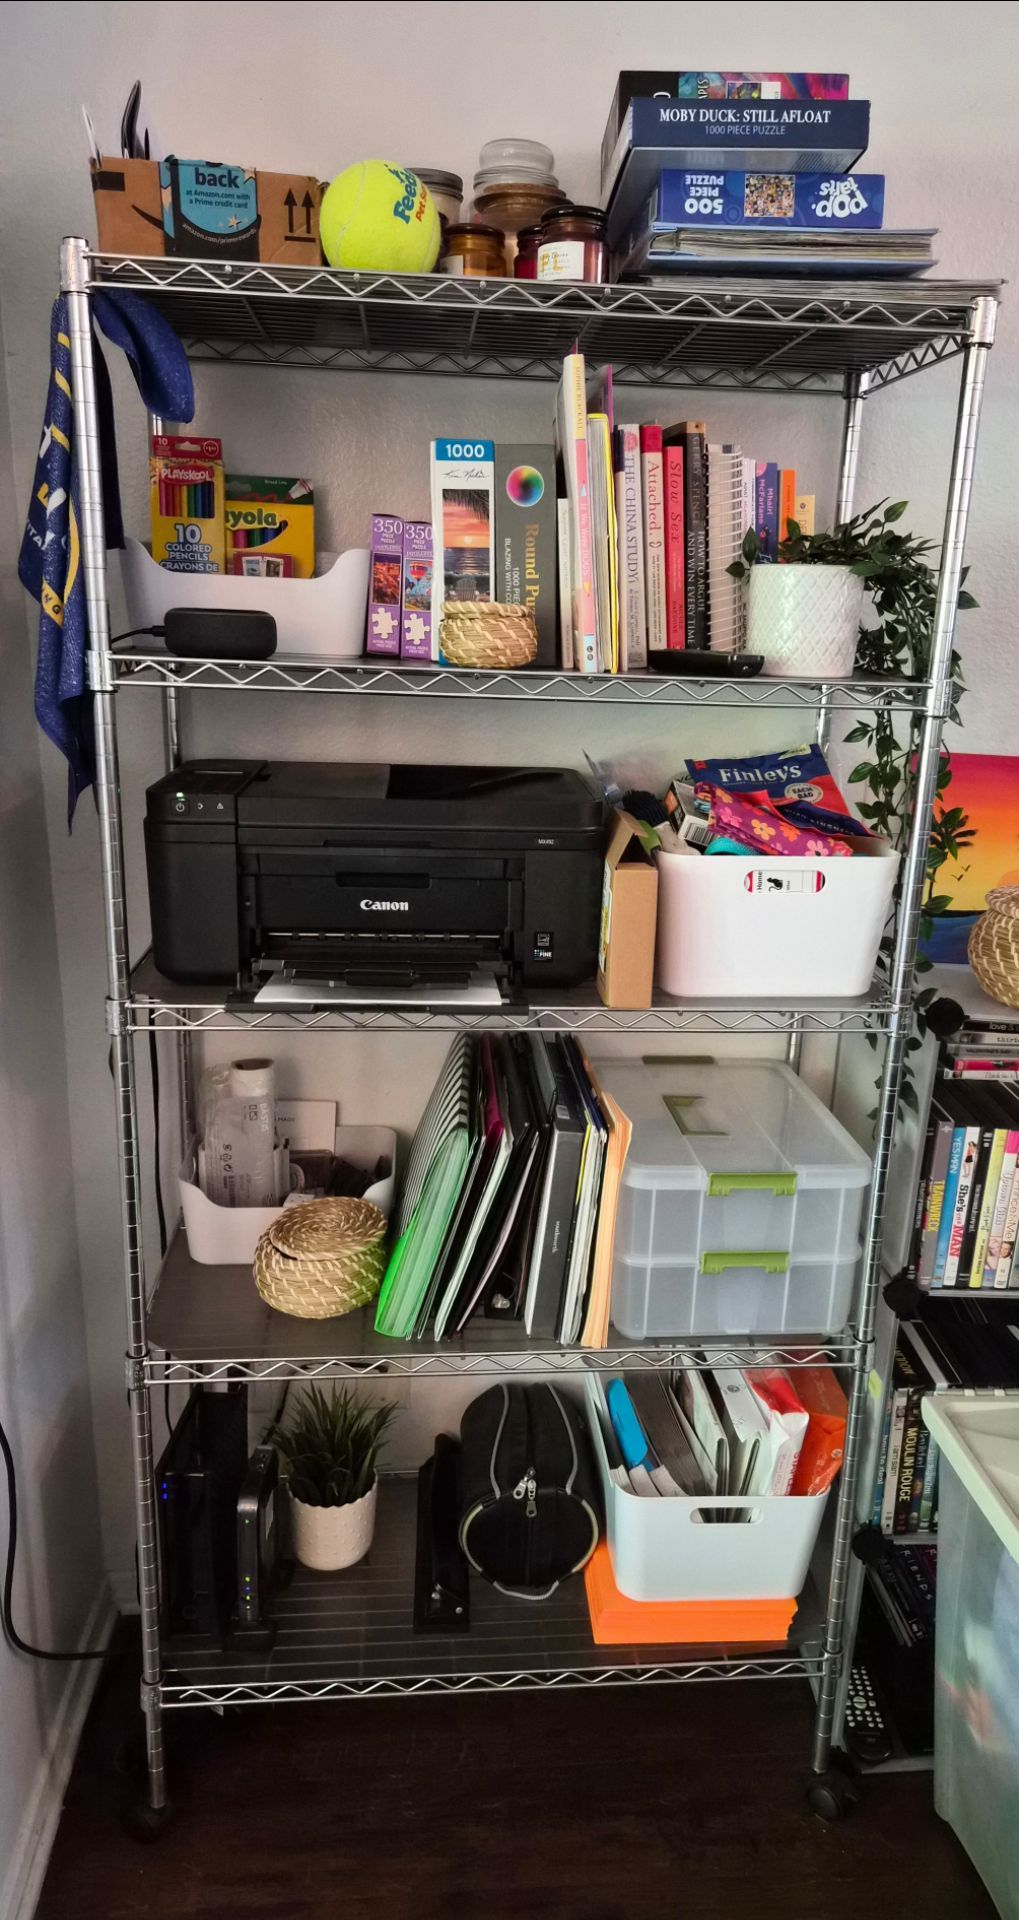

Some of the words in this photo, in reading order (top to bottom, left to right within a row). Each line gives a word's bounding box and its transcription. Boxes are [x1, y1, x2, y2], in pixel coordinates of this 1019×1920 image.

[659, 108, 697, 122] MOBY
[699, 108, 740, 123] DUCK:
[742, 109, 779, 123] STILL
[781, 109, 831, 123] AFLOAT
[705, 125, 726, 135] 1000
[727, 125, 751, 136] PIECE
[752, 125, 786, 136] PUZZLE
[194, 167, 240, 189] back
[685, 174, 725, 186] PUZZLE
[193, 189, 235, 199] Amazon.com
[689, 186, 720, 197] PIECE
[194, 197, 213, 206] Prime
[214, 199, 232, 208] credit
[234, 201, 248, 209] card
[684, 198, 724, 215] 500
[157, 437, 169, 446] 10
[445, 443, 485, 458] 1000
[692, 436, 701, 475] GERRY
[161, 467, 212, 481] PLAYSKOOL
[624, 455, 635, 484] THE
[670, 460, 682, 504] Slow
[648, 460, 662, 536] Attached.
[692, 479, 701, 526] SPENCE
[758, 479, 766, 525] McFarlane
[766, 488, 774, 515] Mhairi
[225, 507, 278, 529] yola
[625, 487, 636, 533] CHINA
[175, 524, 201, 544] 10
[373, 518, 403, 535] 350
[405, 524, 433, 541] 350
[670, 511, 682, 544] Sex
[165, 543, 212, 553] COLORED
[504, 537, 512, 570] BLAZING
[525, 523, 541, 580] Round
[687, 530, 696, 556] AND
[697, 531, 706, 558] HOW
[160, 561, 205, 571] CRAYONS
[205, 563, 219, 572] DE
[169, 551, 209, 561] PENCILS
[626, 535, 638, 581] STUDY
[512, 567, 521, 586] 1000
[687, 558, 696, 582] WIN
[697, 561, 706, 576] TO
[687, 586, 696, 617] EVERY
[697, 577, 706, 612] ARGUE
[687, 619, 696, 645] TIME
[718, 764, 802, 784] Finley's
[791, 786, 814, 795] EACH
[797, 792, 814, 800] BAG
[360, 899, 409, 911] Canon
[951, 1136, 963, 1154] YES
[947, 1153, 959, 1175] MAN
[927, 1180, 947, 1232] TRAINWRECK
[955, 1184, 969, 1213] She's
[949, 1223, 965, 1258] MAN
[903, 1427, 919, 1467] MOULIN
[899, 1468, 914, 1503] ROUGE
